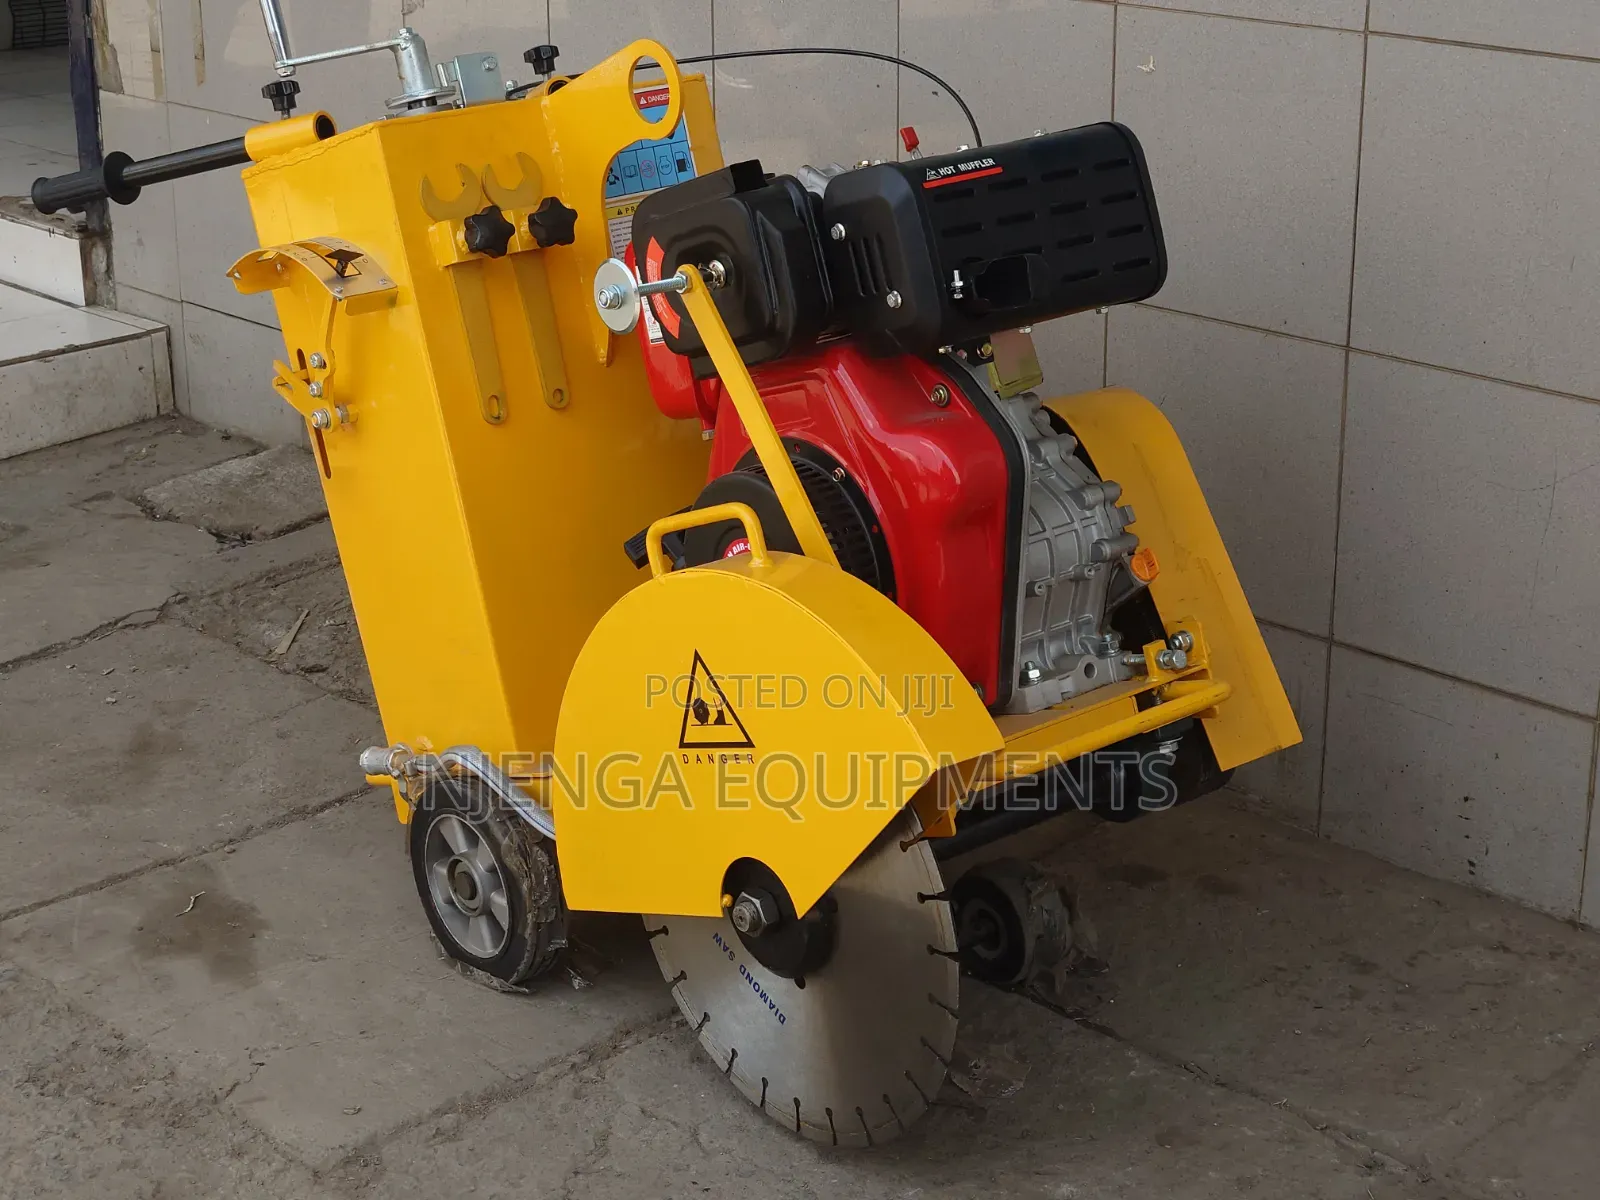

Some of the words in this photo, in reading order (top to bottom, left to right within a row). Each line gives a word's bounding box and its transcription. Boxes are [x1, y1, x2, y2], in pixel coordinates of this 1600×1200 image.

[938, 165, 956, 176] HOT
[957, 157, 996, 172] MUFFLER
[682, 753, 756, 765] DANGER
[712, 932, 736, 962] SAW
[739, 963, 787, 1026] DIAMOND
